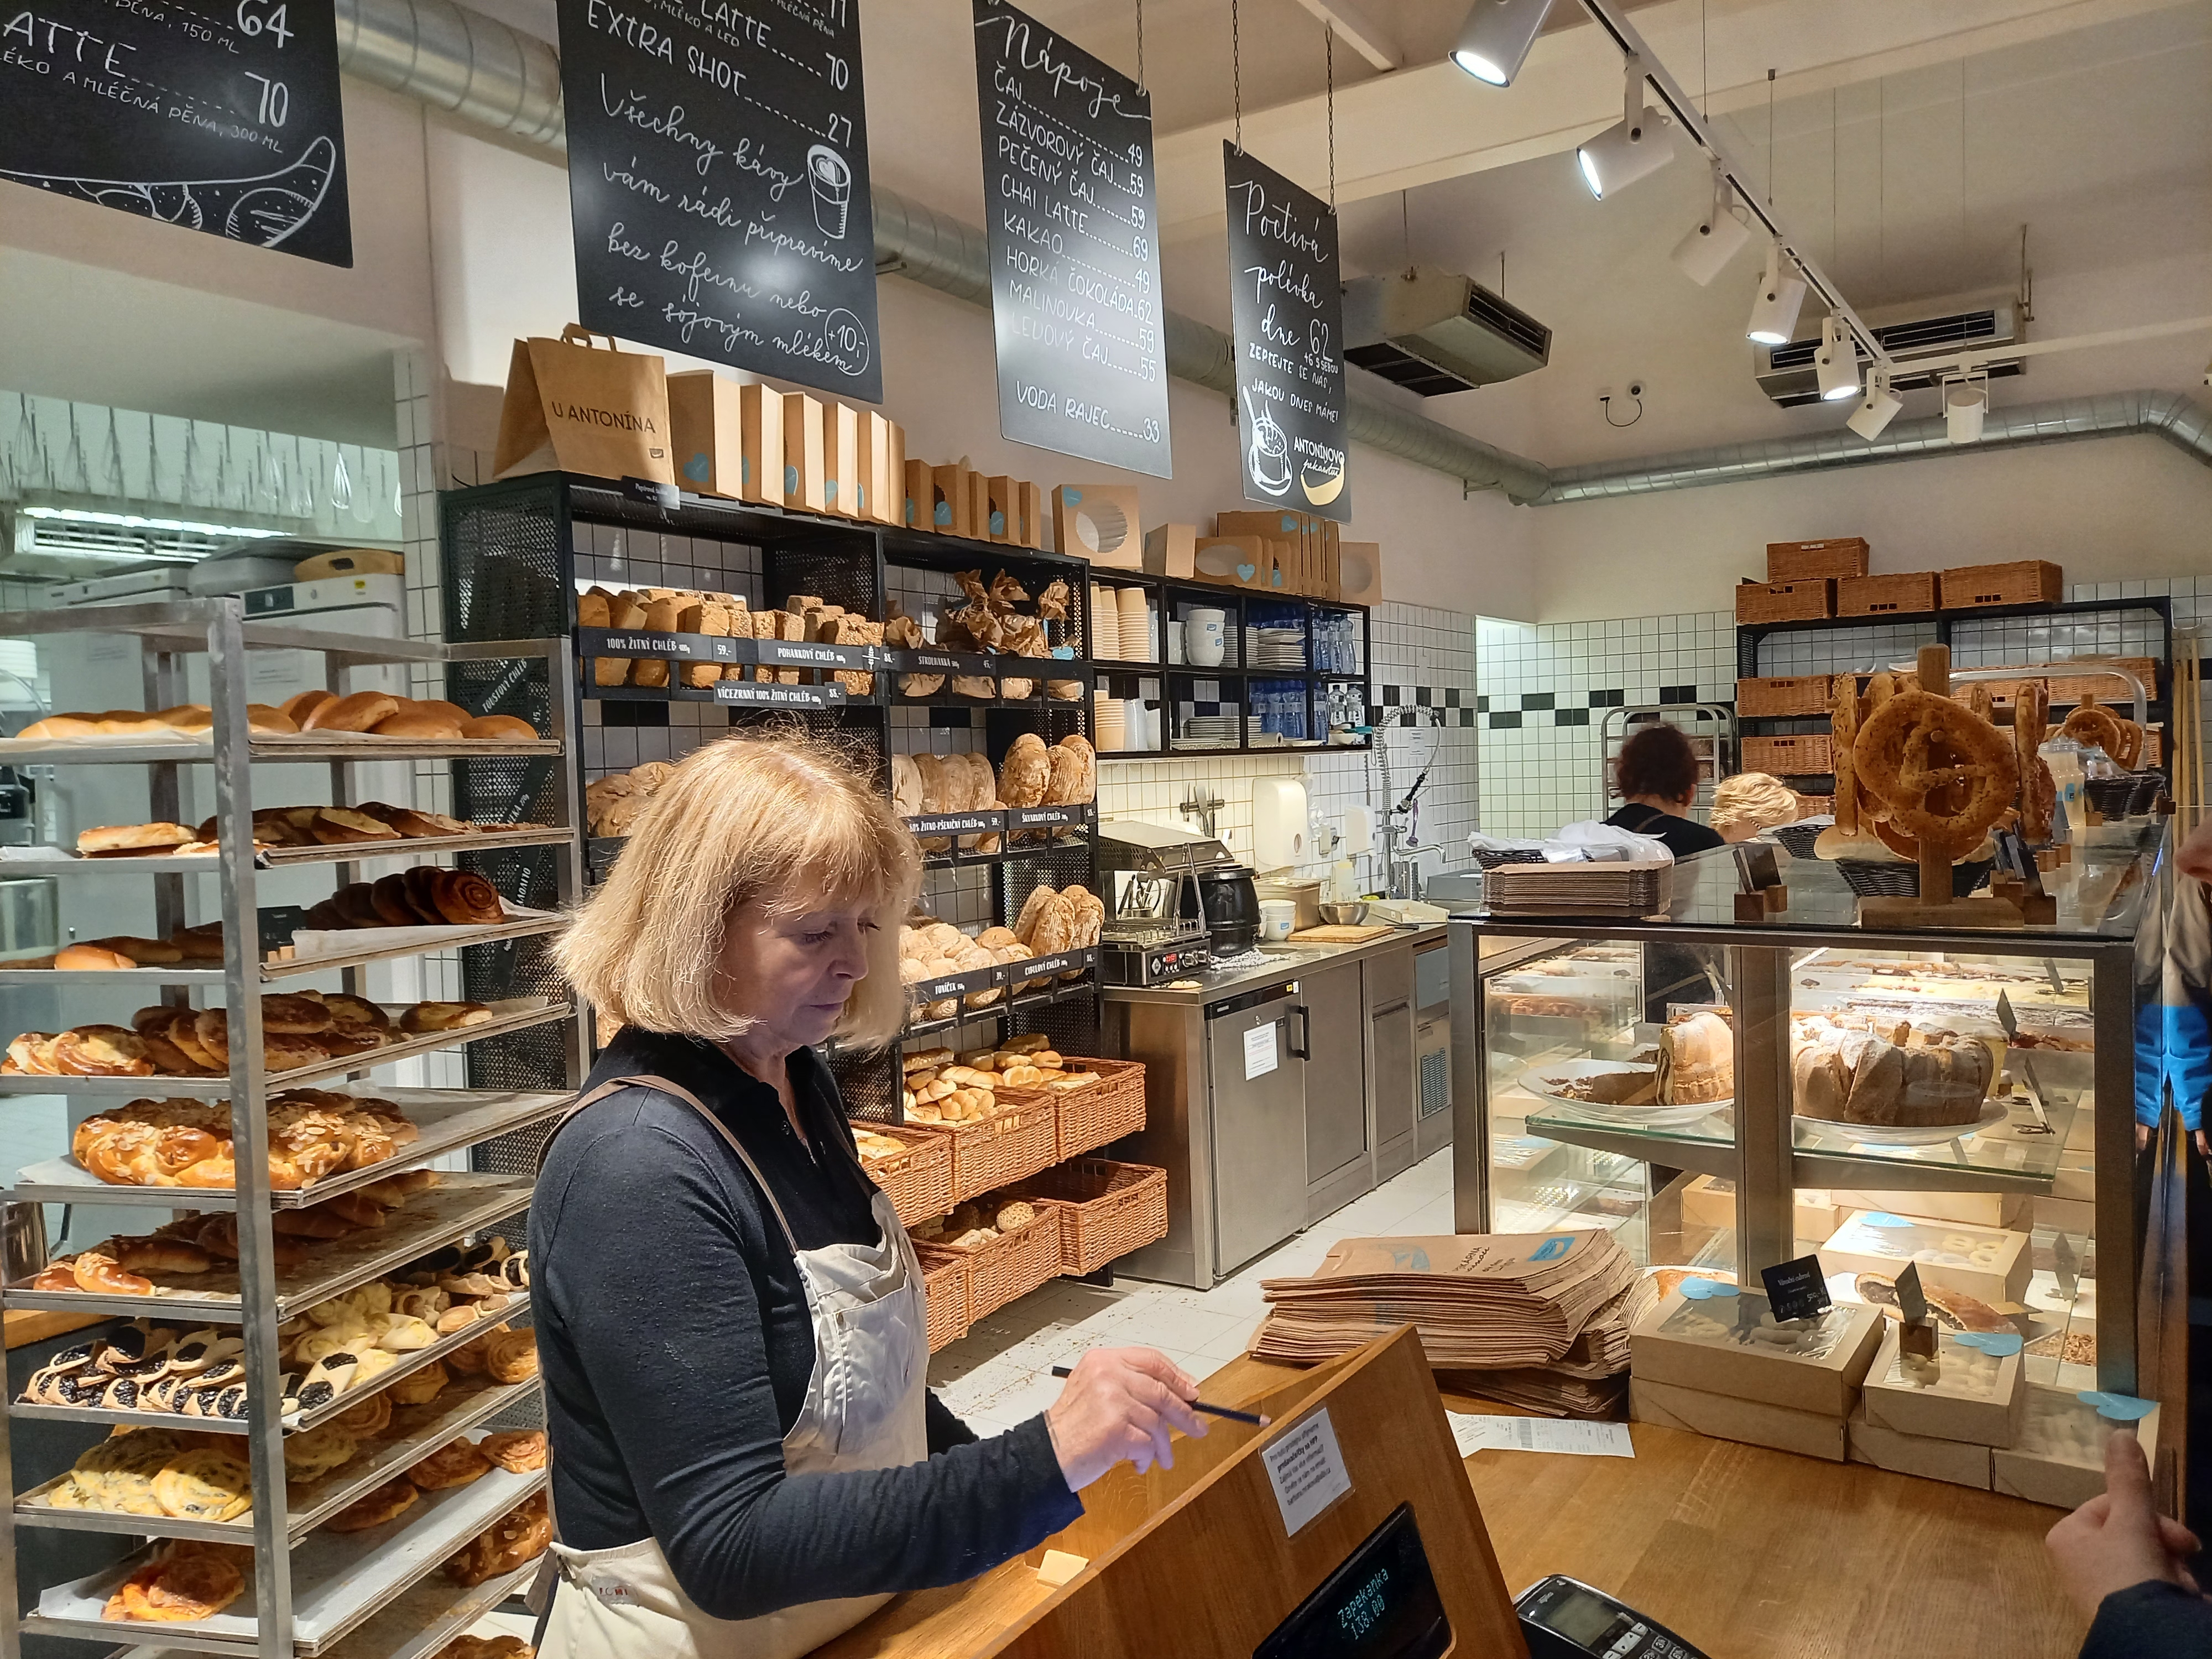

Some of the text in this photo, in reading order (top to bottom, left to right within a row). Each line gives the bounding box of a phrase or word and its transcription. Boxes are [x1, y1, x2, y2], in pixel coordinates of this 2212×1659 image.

[182, 23, 212, 41] 150
[218, 38, 239, 53] ML
[237, 0, 294, 48] 64
[701, 0, 849, 90] LATTE 70
[705, 24, 712, 35] A
[718, 29, 739, 47] LED
[588, 0, 852, 148] EXTRA SHOT 27
[975, 15, 1151, 118] Nápoje
[62, 71, 75, 84] A
[84, 77, 159, 113] MLÉČNÁ
[231, 125, 258, 142] 300
[262, 136, 283, 153] ML
[245, 72, 289, 127] 70
[995, 61, 1142, 168] ČAJ 49
[601, 72, 804, 201] Všechny kávy
[997, 101, 1144, 197] ZÁZVOROVÝ ČAJ 59
[999, 135, 1145, 230] PEČENÝ ČAJ 59
[604, 156, 863, 273] vám rádi připravíme
[1001, 174, 1149, 262] CHAI LATTE 69
[1229, 180, 1328, 263] Poctivá
[608, 222, 827, 317] bez kofeinu nebo
[1004, 208, 1150, 294] KAKAO 49
[1006, 246, 1059, 285] HORKÁ
[1244, 259, 1323, 309] polévka
[609, 286, 644, 307] se
[661, 294, 765, 352] sójovým
[773, 330, 854, 372] mlékem
[1009, 280, 1155, 353] MALINOVKA 59
[1261, 304, 1333, 362] dne 62
[1082, 335, 1108, 365] ČAJ
[1140, 356, 1157, 382] 55
[1249, 342, 1293, 374] ZEPTEJTE
[1299, 365, 1307, 380] SE
[551, 401, 656, 434] U ANTONÍNA
[1016, 380, 1160, 443] VODA RAJEC 33
[1252, 378, 1285, 402] JAKOU
[1290, 393, 1313, 414] DNES
[1294, 436, 1345, 465] ANTONÍNOVO
[607, 637, 626, 649] 100%
[628, 636, 651, 650] ŽITNÝ
[653, 638, 677, 651] CHLÉB
[815, 649, 835, 661] CHLÉB
[755, 690, 770, 701] 100%
[771, 688, 788, 701] ŽITNÝ
[789, 690, 810, 702] CHLÉB
[962, 817, 977, 828] CHLÉB
[1338, 1568, 1389, 1628] Zapekanka
